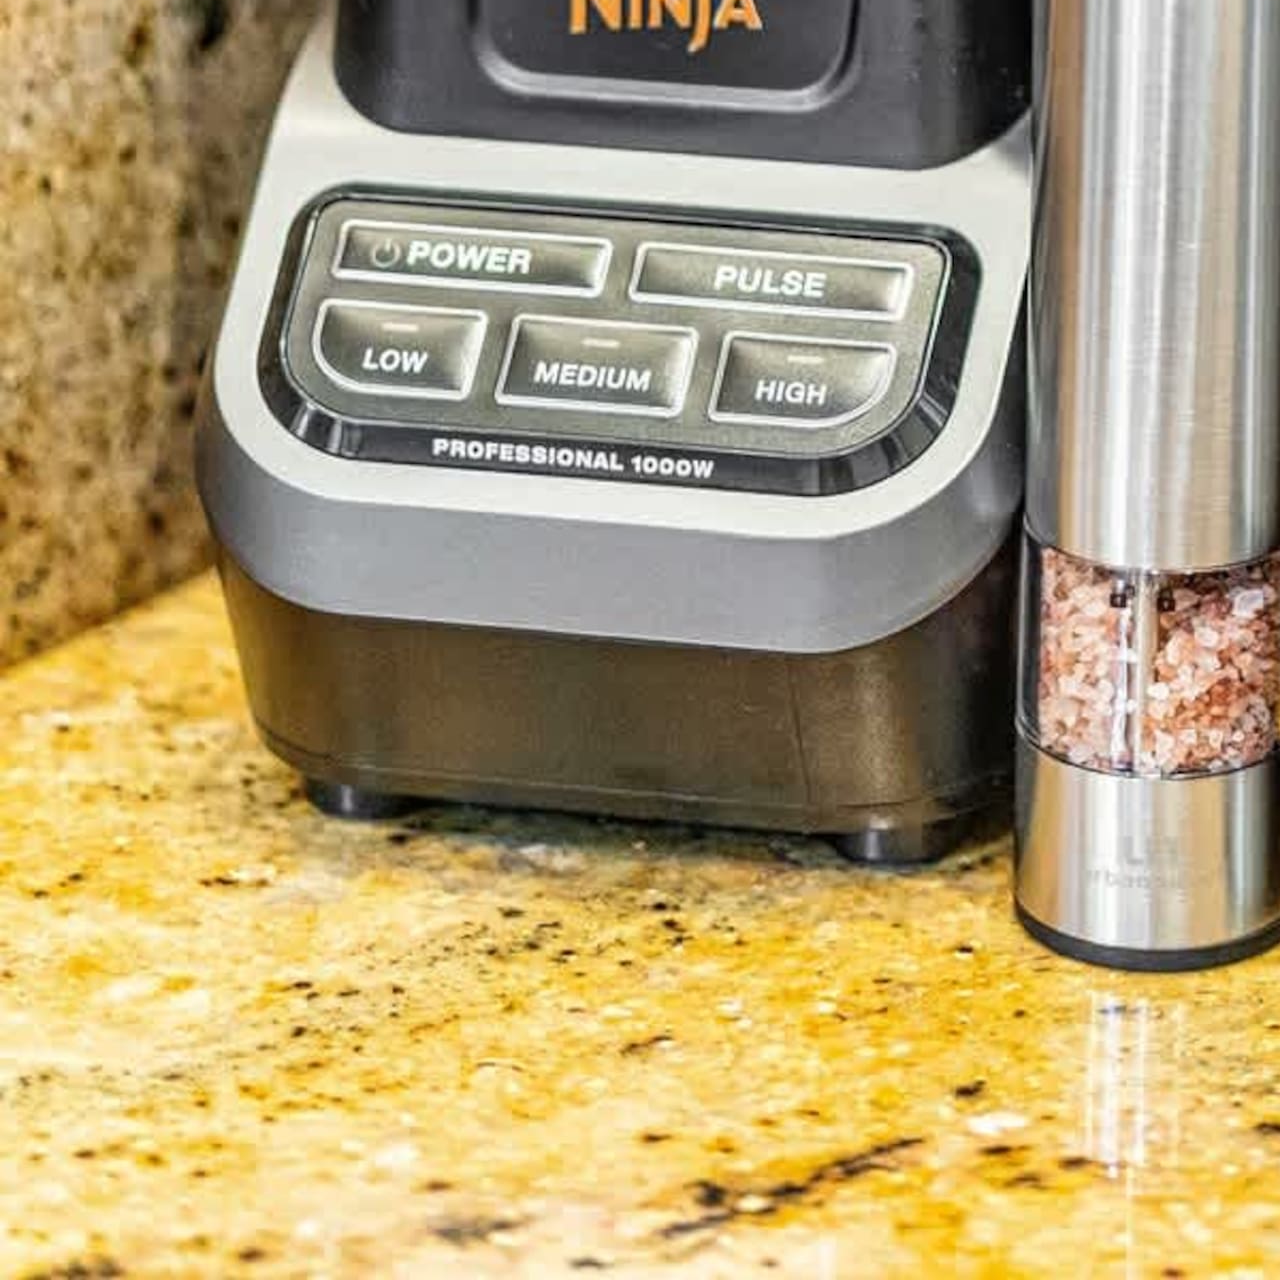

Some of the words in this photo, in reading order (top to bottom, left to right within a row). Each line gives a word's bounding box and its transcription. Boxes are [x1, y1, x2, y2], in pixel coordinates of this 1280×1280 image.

[406, 240, 532, 276] POWER
[714, 265, 826, 299] PULSE
[362, 347, 428, 375] LOW
[534, 362, 650, 393] MEDIUM
[755, 378, 827, 406] HIGH
[432, 438, 625, 472] PROFESSIONAL
[631, 454, 714, 479] 1000W
